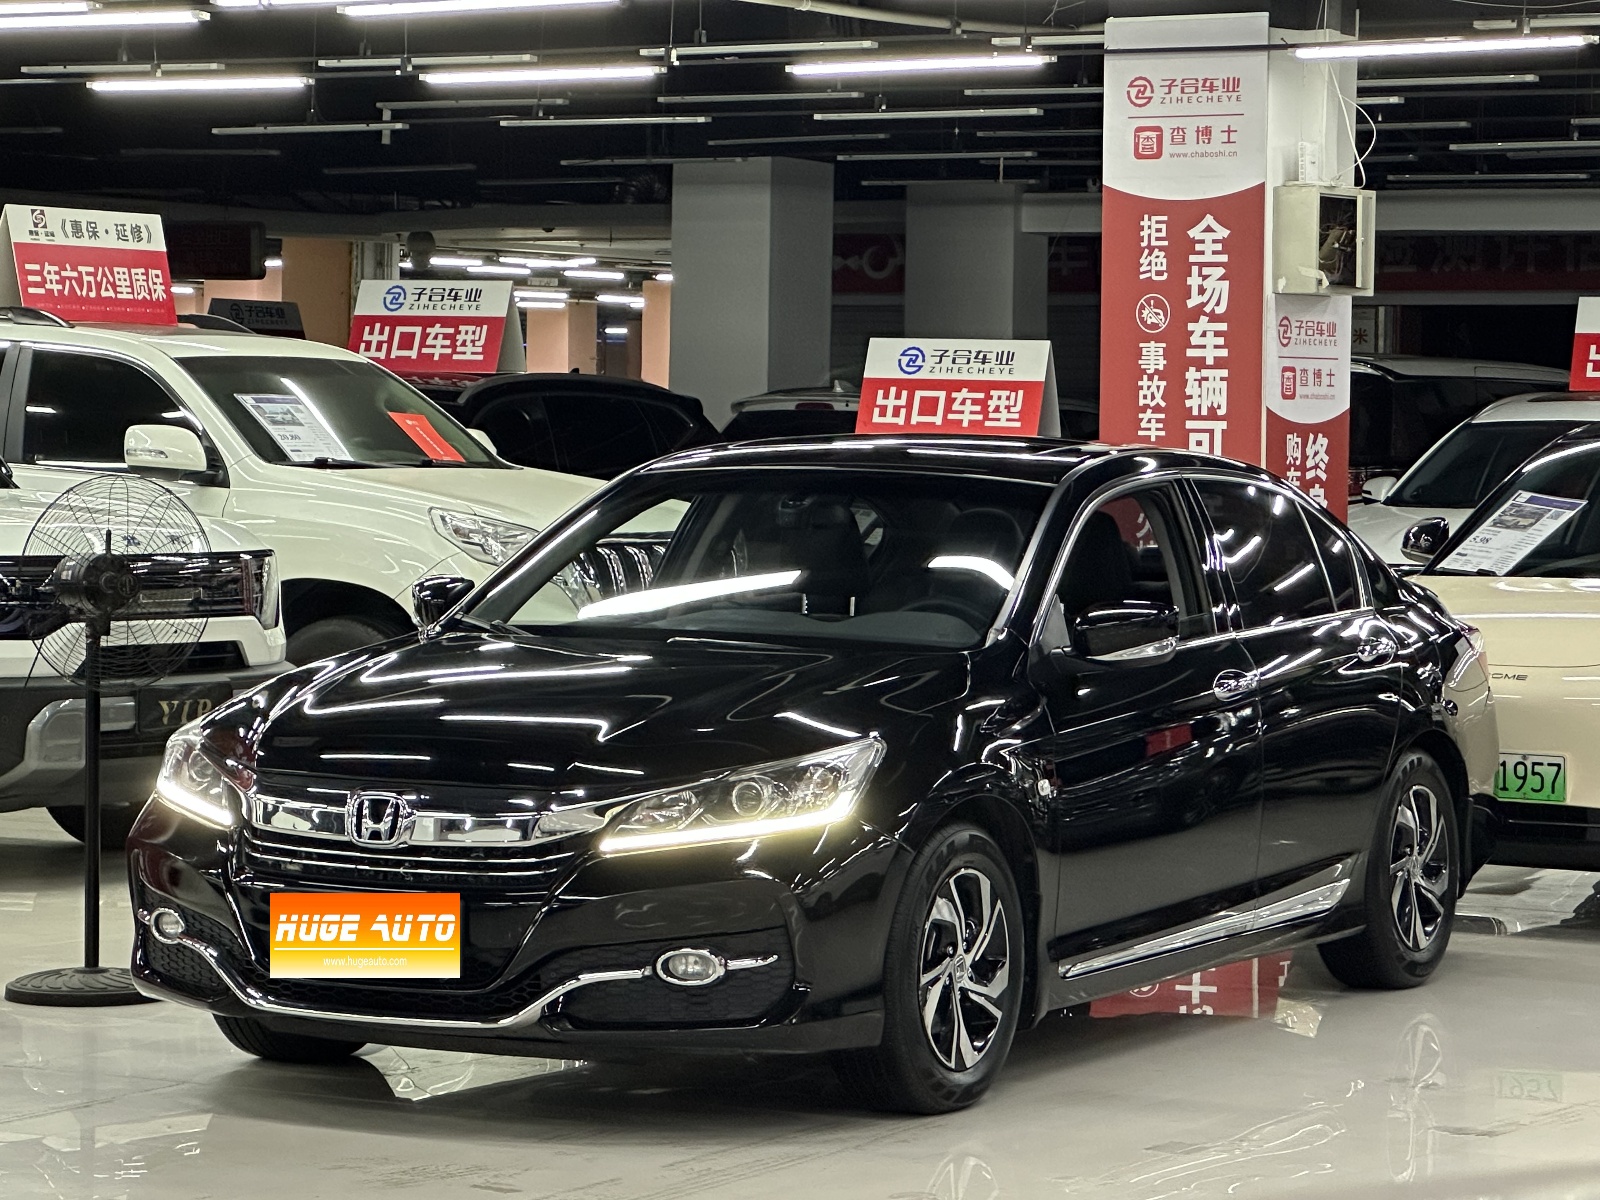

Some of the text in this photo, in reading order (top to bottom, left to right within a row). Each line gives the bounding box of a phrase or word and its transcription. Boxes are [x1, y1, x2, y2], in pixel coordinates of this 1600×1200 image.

[1160, 76, 1241, 95] 子合车业
[1160, 95, 1242, 104] ZIHECHEYE
[1169, 125, 1238, 146] 查博士
[1169, 150, 1238, 158] www.chaboshi.cn
[24, 262, 167, 301] 三年六万公里质保
[411, 287, 483, 303] 子合车业
[408, 303, 482, 311] ZIHECHEYE
[1137, 214, 1169, 441] 拒绝 事故车
[1184, 213, 1231, 456] 全场车辆可
[1294, 319, 1337, 337] 子合车业
[359, 322, 488, 361] 出口车型
[1294, 338, 1338, 347] ZIHECHEYE
[930, 349, 1016, 366] 子合车业
[929, 366, 1015, 375] ZIHECHEYE
[1299, 367, 1336, 388] 查博士
[871, 386, 1025, 428] 出口车型
[1498, 760, 1562, 795] 1957
